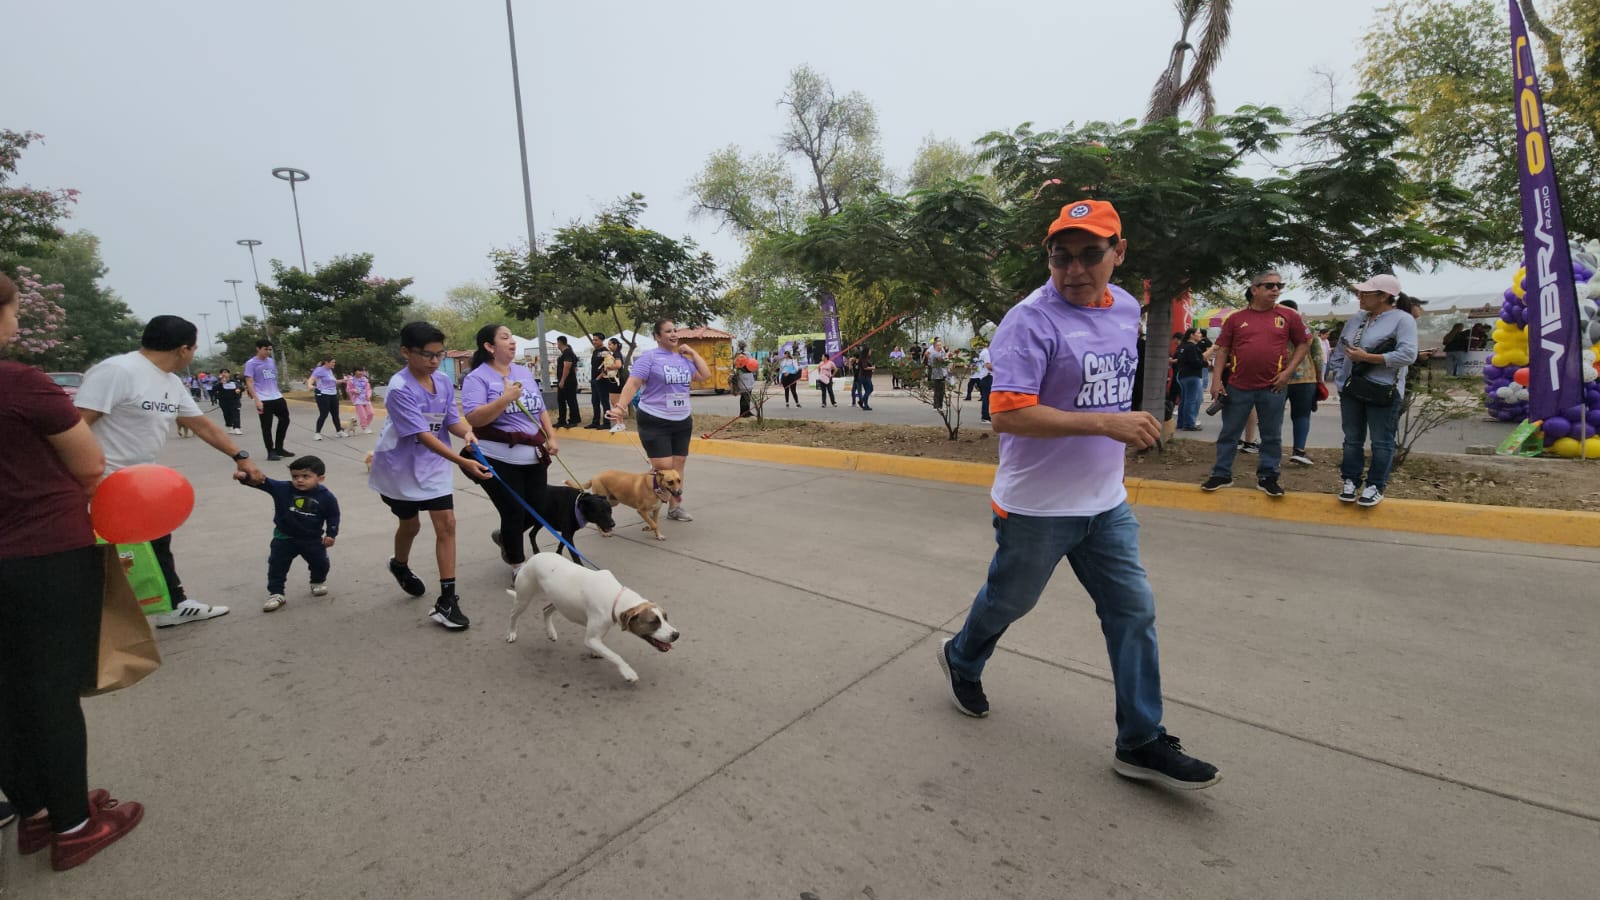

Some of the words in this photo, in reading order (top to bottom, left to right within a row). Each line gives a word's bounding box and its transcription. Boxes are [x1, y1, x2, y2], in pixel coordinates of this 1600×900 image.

[1541, 185, 1552, 230] RADIO
[1534, 188, 1565, 392] VIBRA
[673, 399, 685, 407] 191
